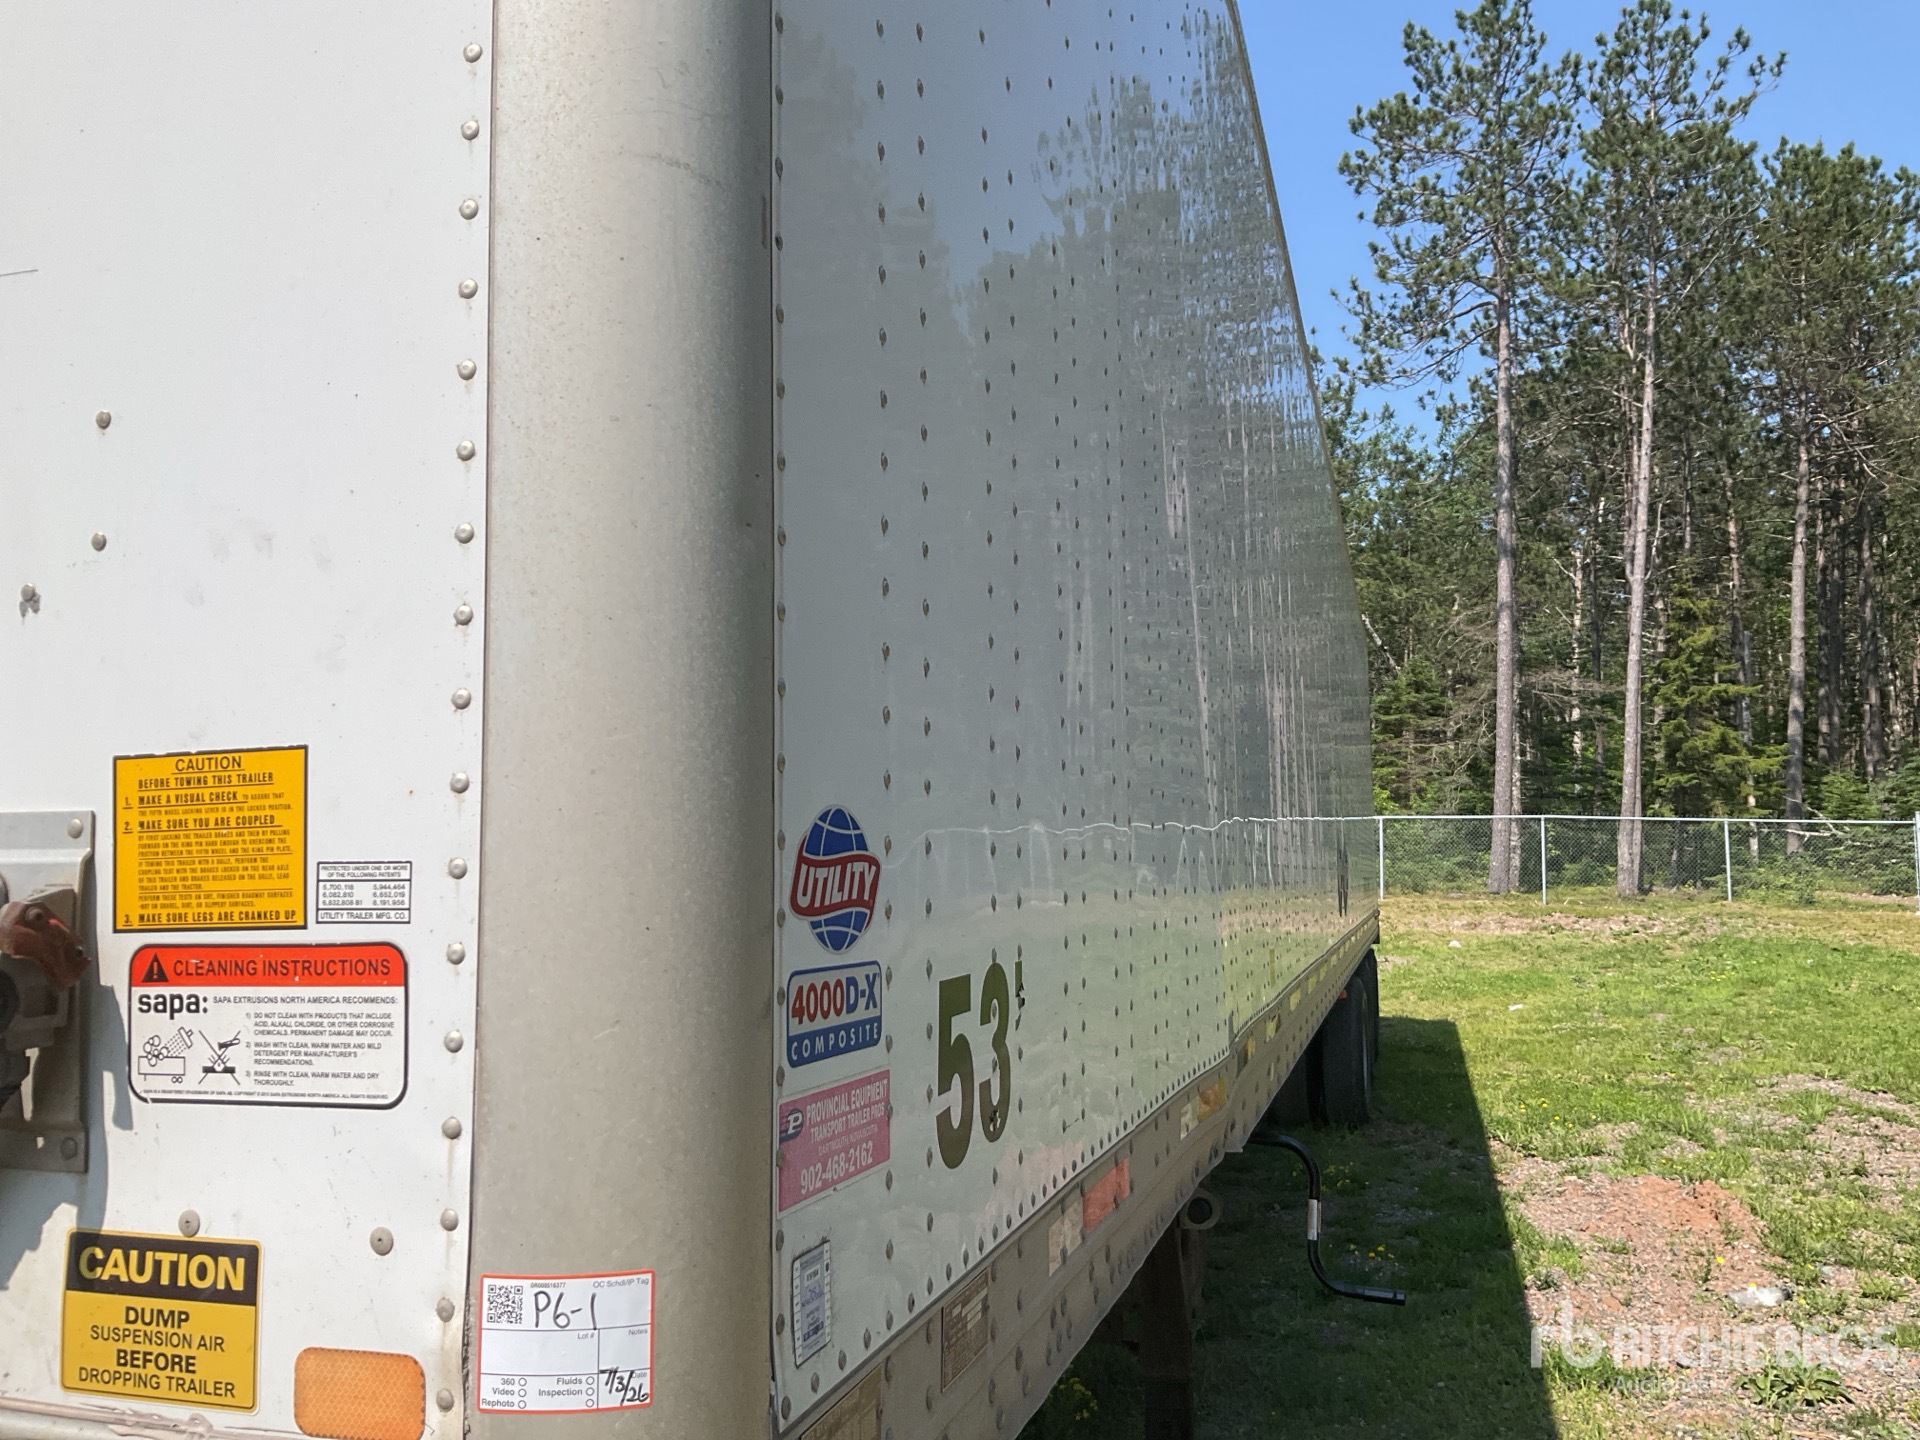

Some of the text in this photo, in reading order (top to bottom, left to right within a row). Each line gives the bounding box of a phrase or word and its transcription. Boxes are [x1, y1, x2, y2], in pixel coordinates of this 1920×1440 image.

[176, 756, 241, 771] CAUTION
[138, 772, 273, 789] BEFORE TOWING THIS TRAILER
[125, 797, 131, 806] 1.
[138, 795, 161, 805] MAKE
[166, 794, 171, 804] A
[175, 793, 205, 803] VISUAL
[209, 791, 237, 802] CHECK
[124, 815, 275, 830] 2. MAKE SURE YOU ARE COUPLED
[797, 862, 877, 907] UTILITY
[124, 910, 296, 923] 3. MAKE SURE LEGS ARE CRANKED UP
[174, 959, 390, 976] CLEANING INSTRUCTIONS
[213, 996, 398, 1004] SAPA EXTRUSIONS NORTH AMERICA RECOMMENDS:
[791, 1022, 878, 1060] COMPOSITE
[807, 1079, 888, 1125] PROVINCIAL EQUIPMENT
[811, 1117, 846, 1143] TRANSPORT
[848, 1107, 871, 1128] TRAILER
[801, 1141, 873, 1194] 902-468-2162
[79, 1246, 245, 1291] CAUTION
[637, 1278, 649, 1286] Tag
[125, 1306, 190, 1329] DUMP
[90, 1325, 225, 1352] SUSPENSION AIR
[116, 1349, 196, 1373] BEFORE
[79, 1367, 235, 1398] DROPPING TRAILER
[557, 1377, 582, 1385] Fluids
[492, 1388, 515, 1396] Video
[539, 1388, 582, 1397] Inspection
[481, 1399, 515, 1408] Rephoto
